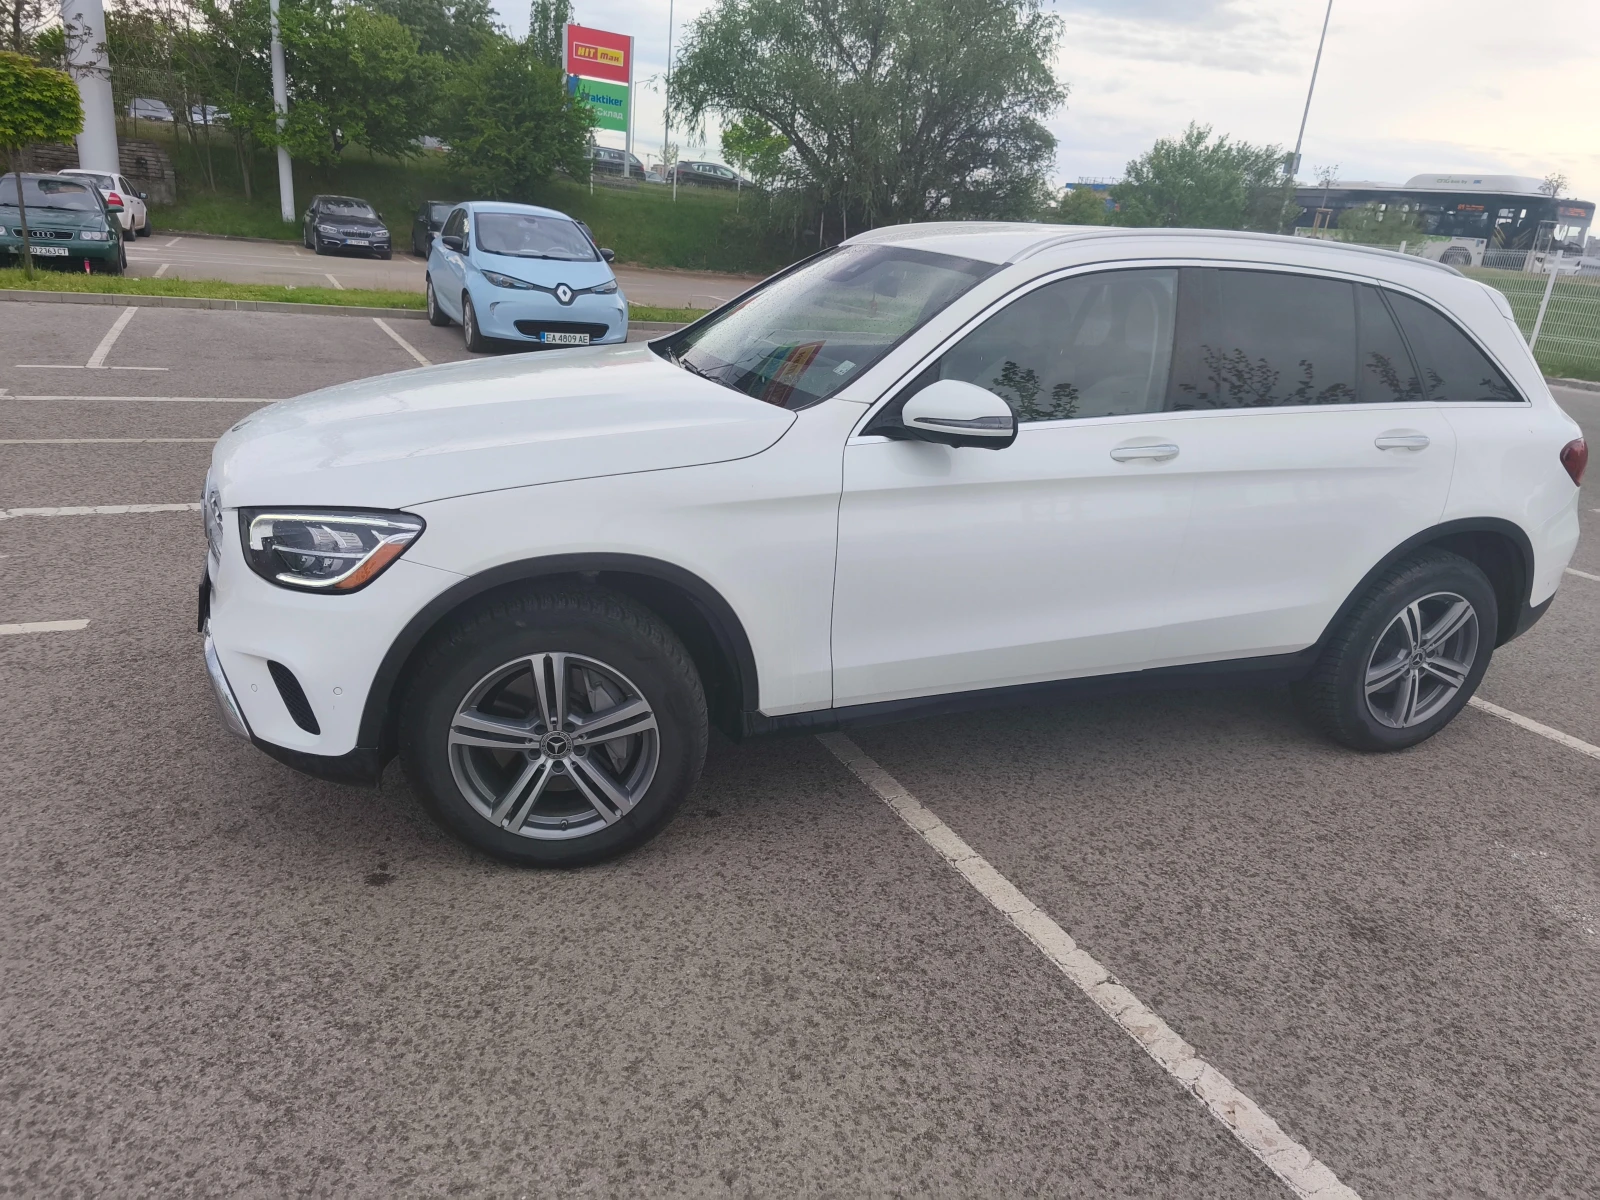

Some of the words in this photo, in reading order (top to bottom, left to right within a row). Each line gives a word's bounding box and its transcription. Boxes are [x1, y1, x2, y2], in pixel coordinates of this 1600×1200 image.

[577, 46, 596, 58] HIT
[597, 107, 624, 120] Склад
[39, 247, 57, 255] 2363
[545, 333, 557, 343] EA
[557, 334, 577, 343] 4809
[578, 335, 589, 344] AE
